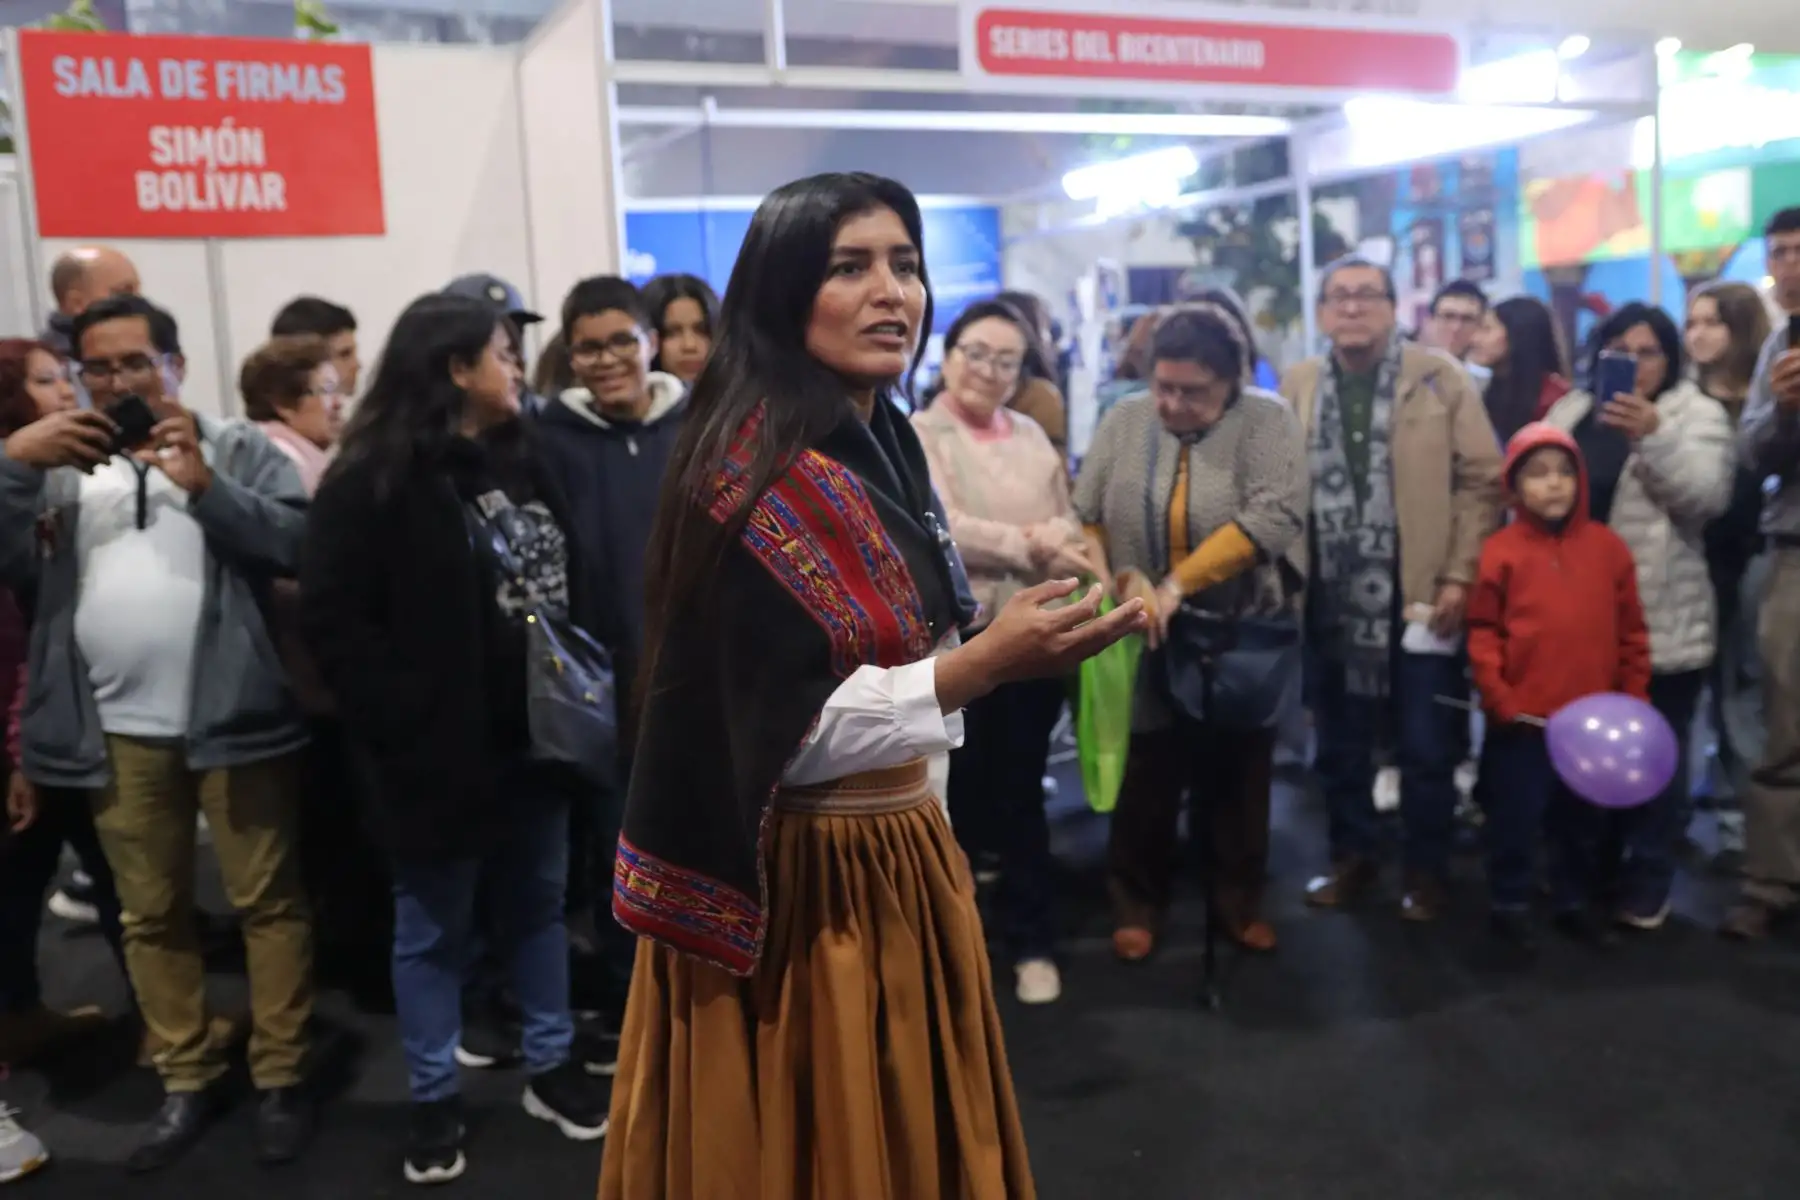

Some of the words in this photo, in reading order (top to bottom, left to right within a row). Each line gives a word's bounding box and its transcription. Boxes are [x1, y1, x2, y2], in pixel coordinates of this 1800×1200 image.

[989, 26, 1068, 60] SERIES
[1072, 30, 1114, 63] DEL
[1117, 32, 1265, 69] BICENTENARIO
[53, 55, 150, 98] SALA
[158, 58, 208, 100] DE
[214, 60, 346, 104] FIRMAS
[149, 117, 266, 168] SIMÓN
[135, 165, 287, 212] BOLÍVAR
